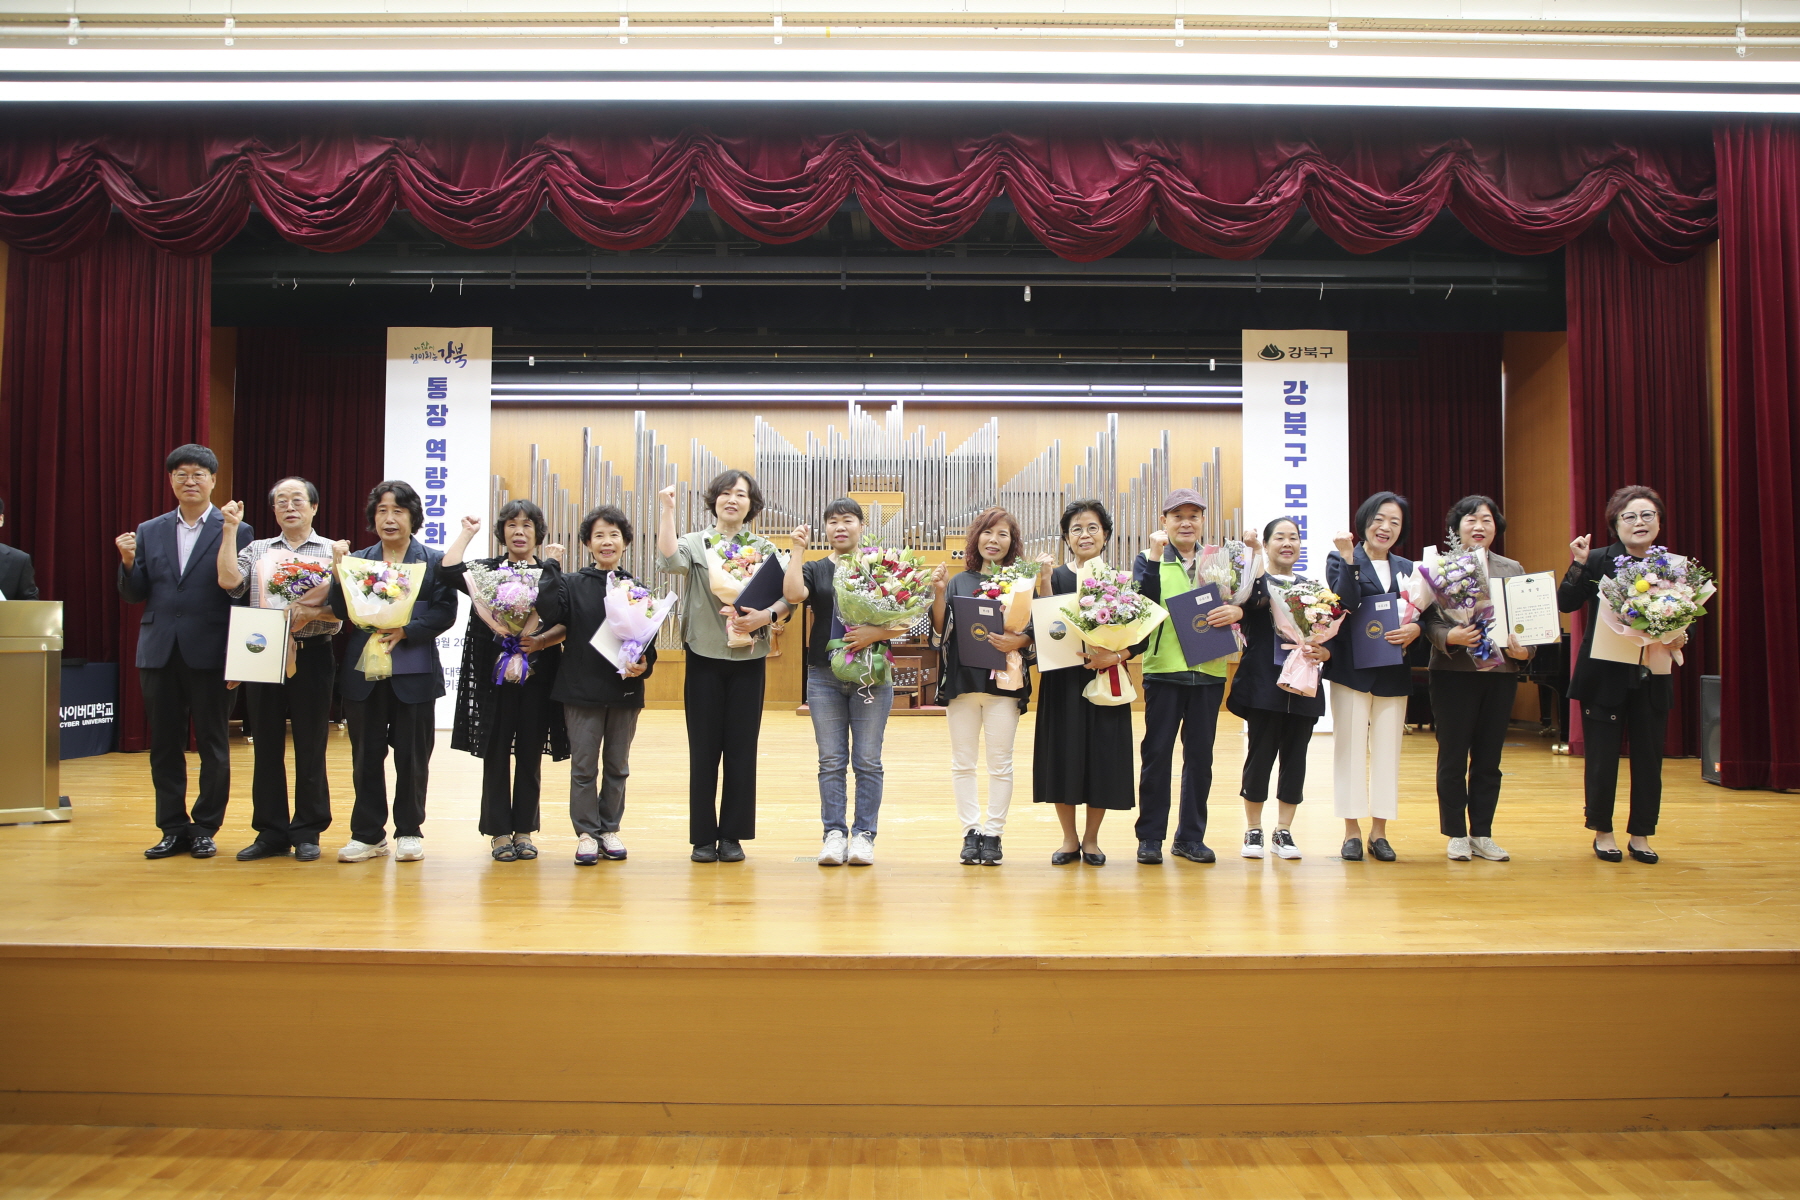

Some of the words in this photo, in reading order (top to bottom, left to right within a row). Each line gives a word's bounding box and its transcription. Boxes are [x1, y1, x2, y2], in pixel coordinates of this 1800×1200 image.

[438, 341, 468, 368] 강북
[1288, 346, 1334, 359] 강북구
[426, 376, 449, 427] 통장
[1283, 380, 1309, 468] 강북구
[424, 438, 449, 545] 역량강화
[59, 702, 114, 721] 사이버대학교
[59, 720, 80, 728] CYBER
[82, 717, 114, 726] UNIVERSITY
